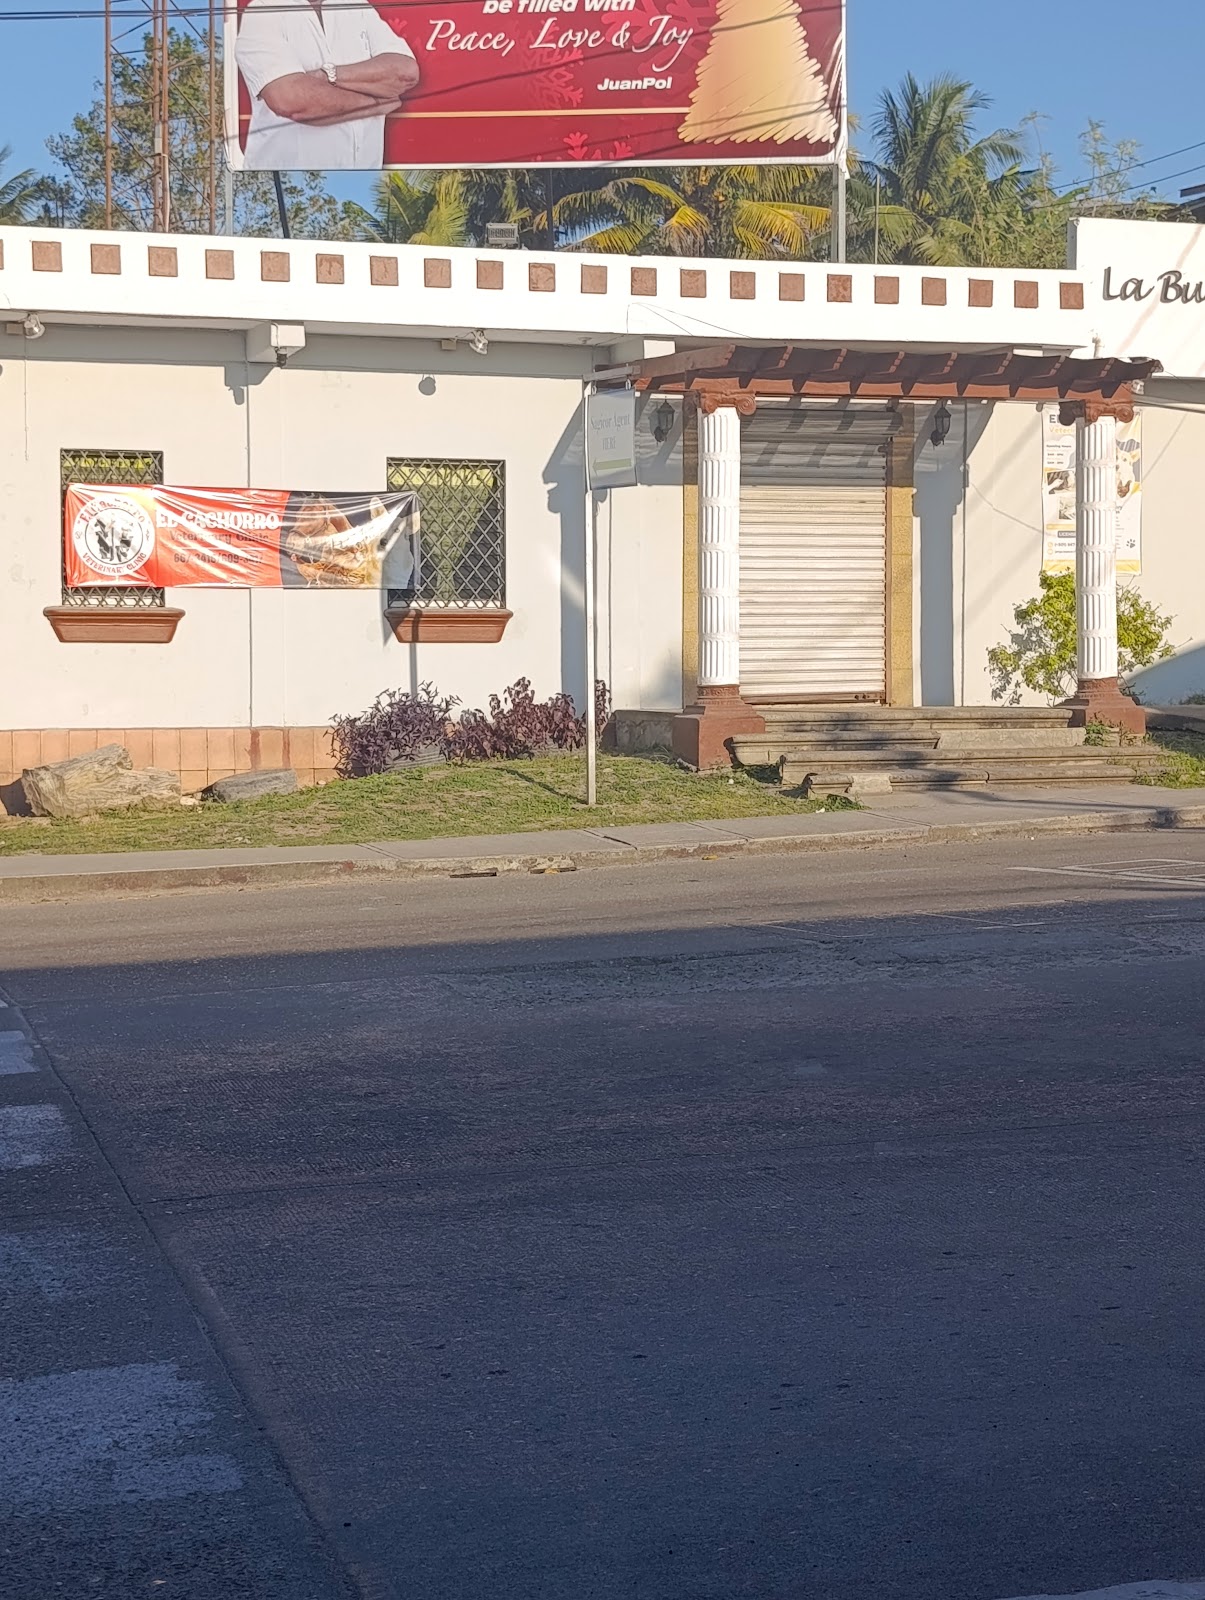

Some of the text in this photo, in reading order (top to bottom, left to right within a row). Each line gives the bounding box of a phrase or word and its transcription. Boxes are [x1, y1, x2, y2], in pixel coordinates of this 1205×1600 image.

[482, 0, 636, 14] be filled with
[425, 15, 694, 72] Peace, Love & Joy
[597, 76, 673, 91] JuanPol
[1102, 266, 1155, 302] La
[156, 509, 178, 528] EL
[170, 530, 232, 544] Veterary
[82, 552, 147, 574] VETERINAR CLINIC
